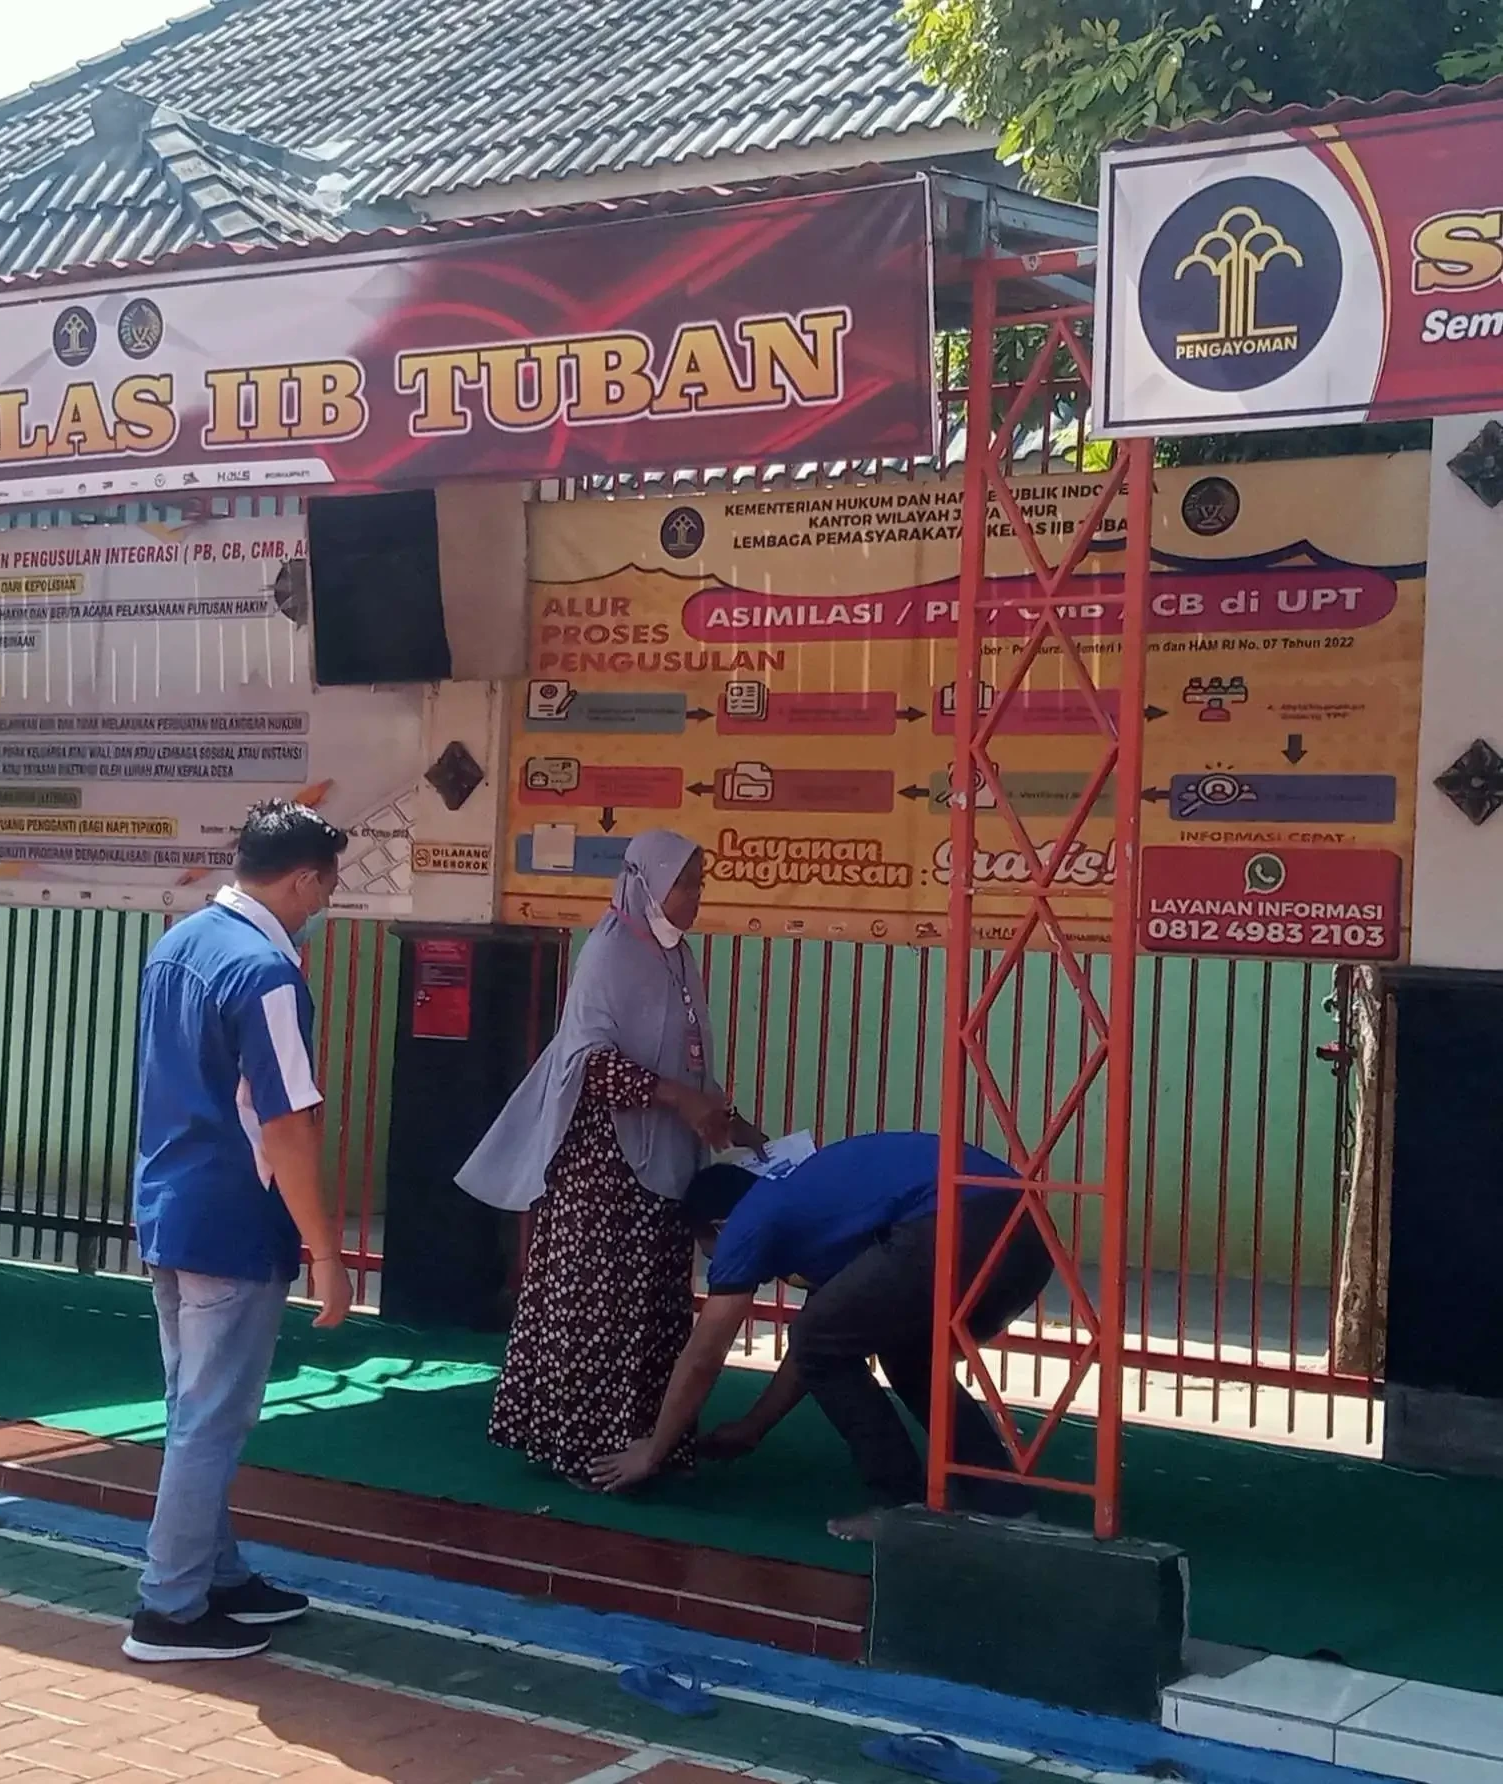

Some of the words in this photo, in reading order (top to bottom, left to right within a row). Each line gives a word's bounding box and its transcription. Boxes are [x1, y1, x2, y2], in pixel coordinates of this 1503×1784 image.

[1175, 336, 1298, 360] PENGAYOMAN
[204, 358, 368, 447] IIB
[398, 308, 851, 435] TUBAN
[725, 498, 833, 517] KEMENTERIAN
[836, 495, 893, 511] HUKUM
[897, 492, 930, 507] DAN
[809, 514, 872, 529] KANTOR
[876, 508, 949, 525] WILAYAH
[733, 532, 812, 549] LEMBAGA
[816, 525, 964, 546] PEMASYARAKATA
[1050, 519, 1075, 535] IIB
[13, 546, 101, 570] PENGUSULAN
[106, 544, 178, 565] INTEGRASI
[193, 543, 217, 564] PB,
[222, 542, 246, 563] CB,
[251, 540, 288, 560] CMB,
[542, 597, 631, 618] ALUR
[707, 603, 884, 628] ASIMILASI
[896, 601, 911, 625] /
[1151, 593, 1205, 617] CB
[1220, 590, 1261, 614] di
[1277, 587, 1363, 612] UPT
[542, 624, 670, 646] PROSES
[1263, 638, 1278, 650] 07
[1281, 637, 1321, 650] Tahun
[1324, 636, 1355, 649] 2022
[539, 649, 786, 674] PENGUSULAN
[719, 829, 884, 867] Layanan
[1180, 830, 1282, 843] INFORMASI
[1288, 831, 1346, 844] CEPAT
[207, 852, 237, 866] TERO
[432, 848, 489, 859] DILARANG
[432, 859, 488, 870] MEROKOK
[1150, 899, 1254, 917] LAYANAN
[1257, 900, 1383, 920] INFORMASI
[1147, 919, 1219, 942] 0812
[1226, 920, 1303, 944] 4983
[1310, 923, 1385, 948] 2103
